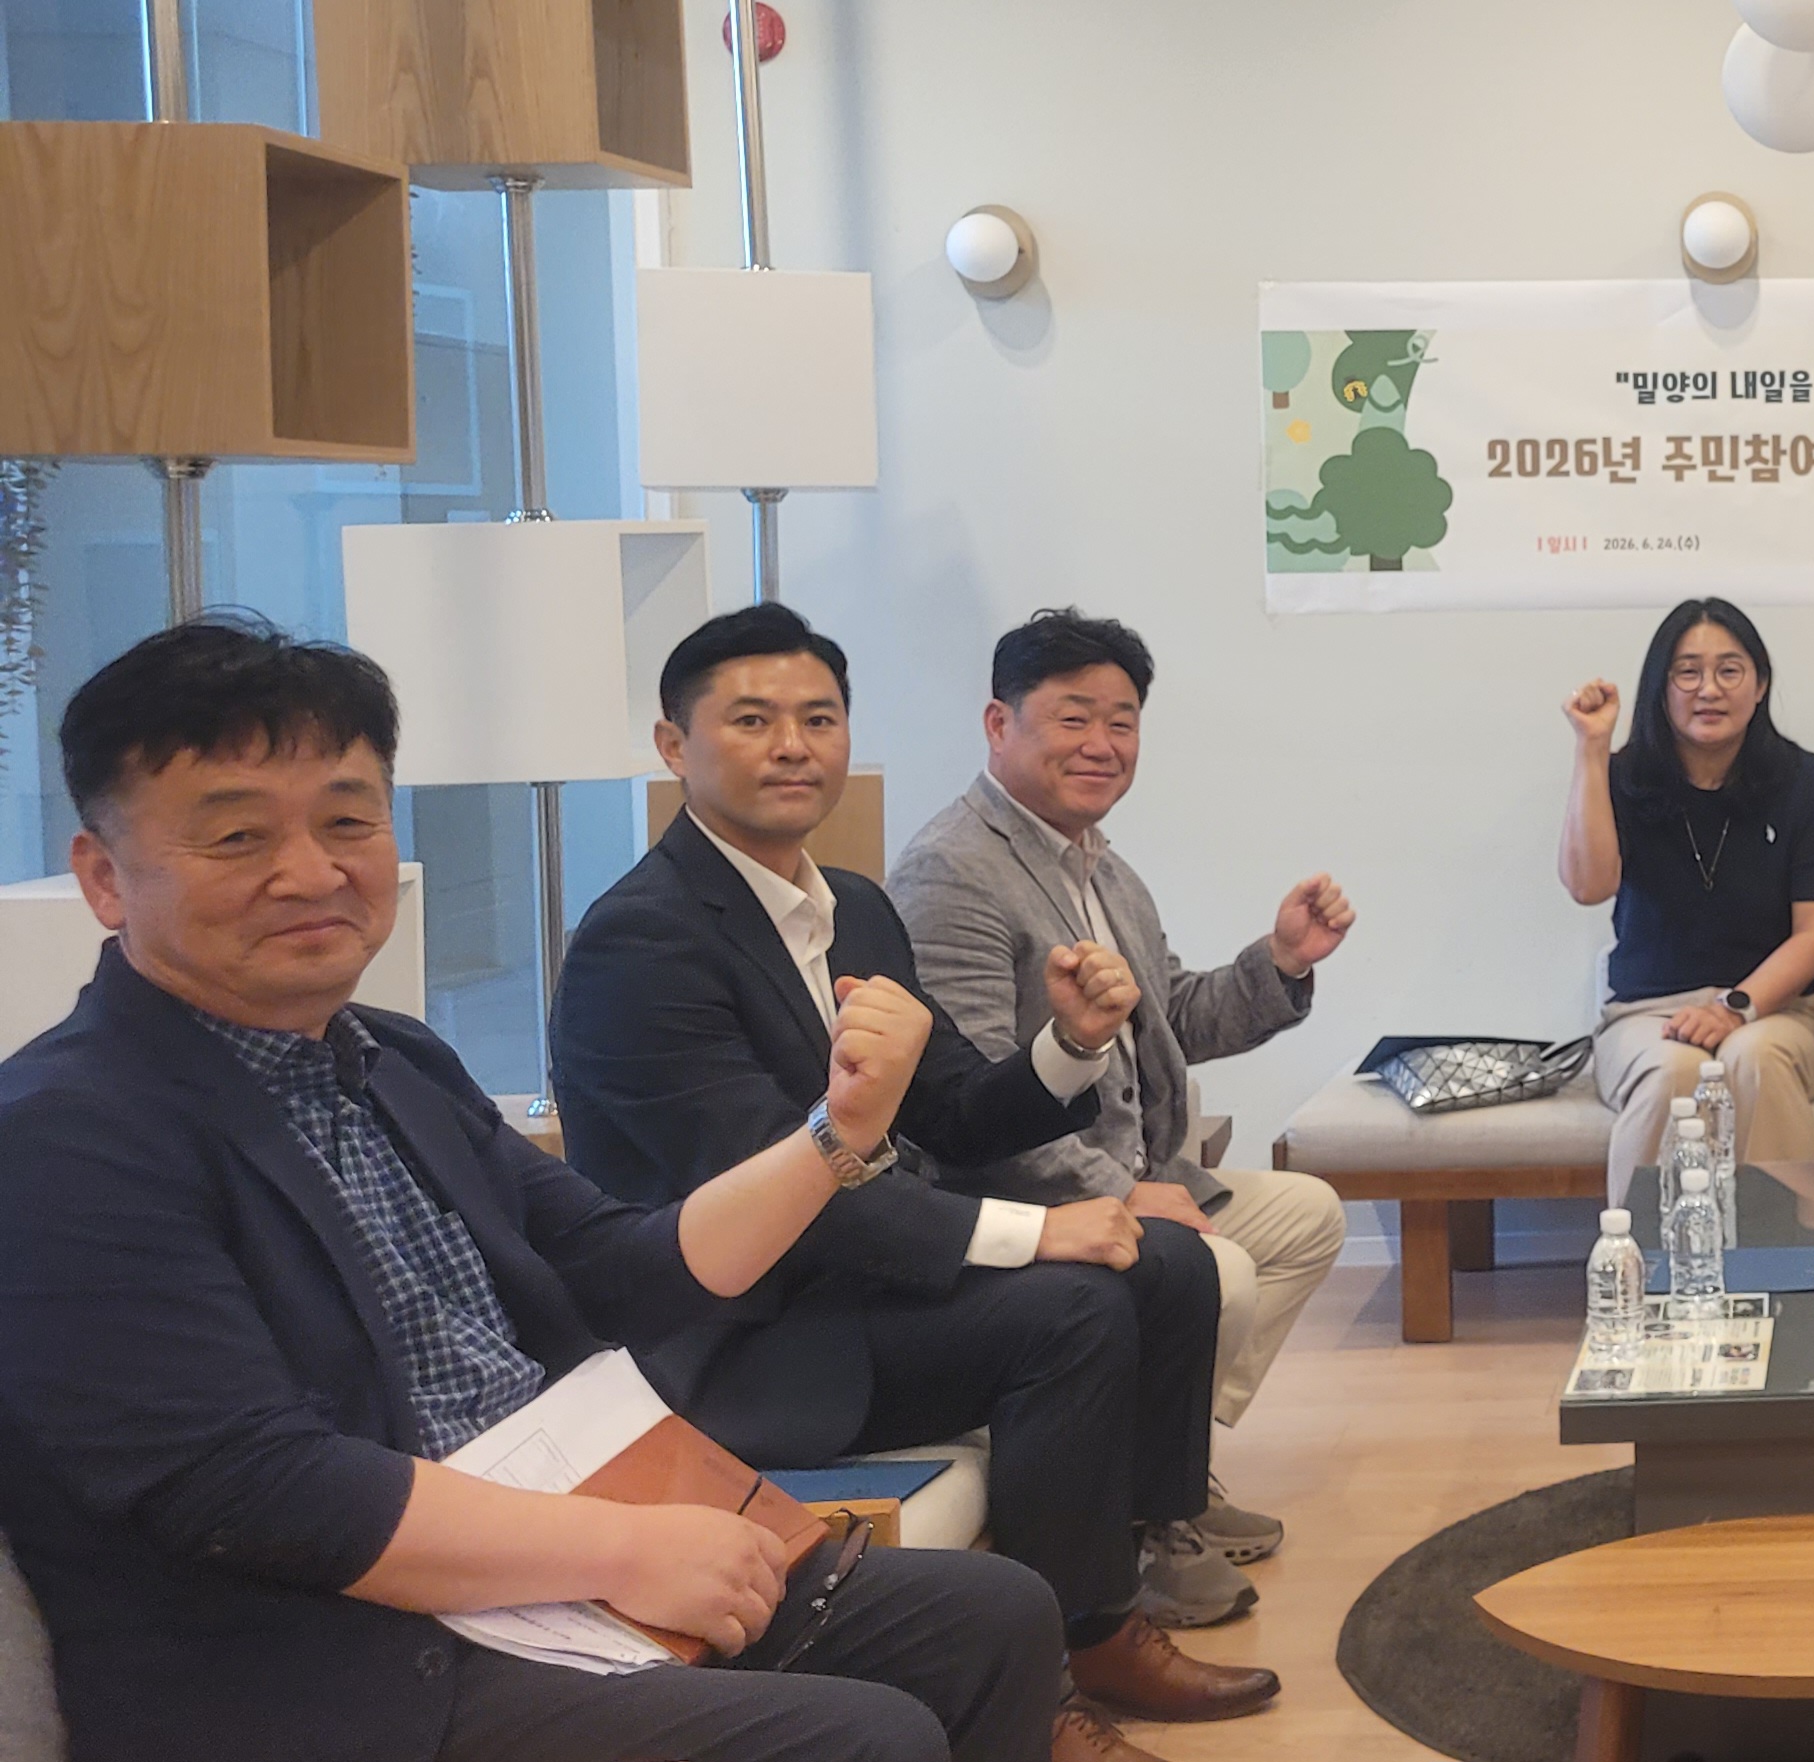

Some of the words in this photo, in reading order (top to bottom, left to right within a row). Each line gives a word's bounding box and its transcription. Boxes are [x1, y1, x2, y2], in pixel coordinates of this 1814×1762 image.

[1615, 370, 1718, 405] "밀양의
[1730, 369, 1813, 404] 내일을
[1487, 436, 1642, 484] 2026년
